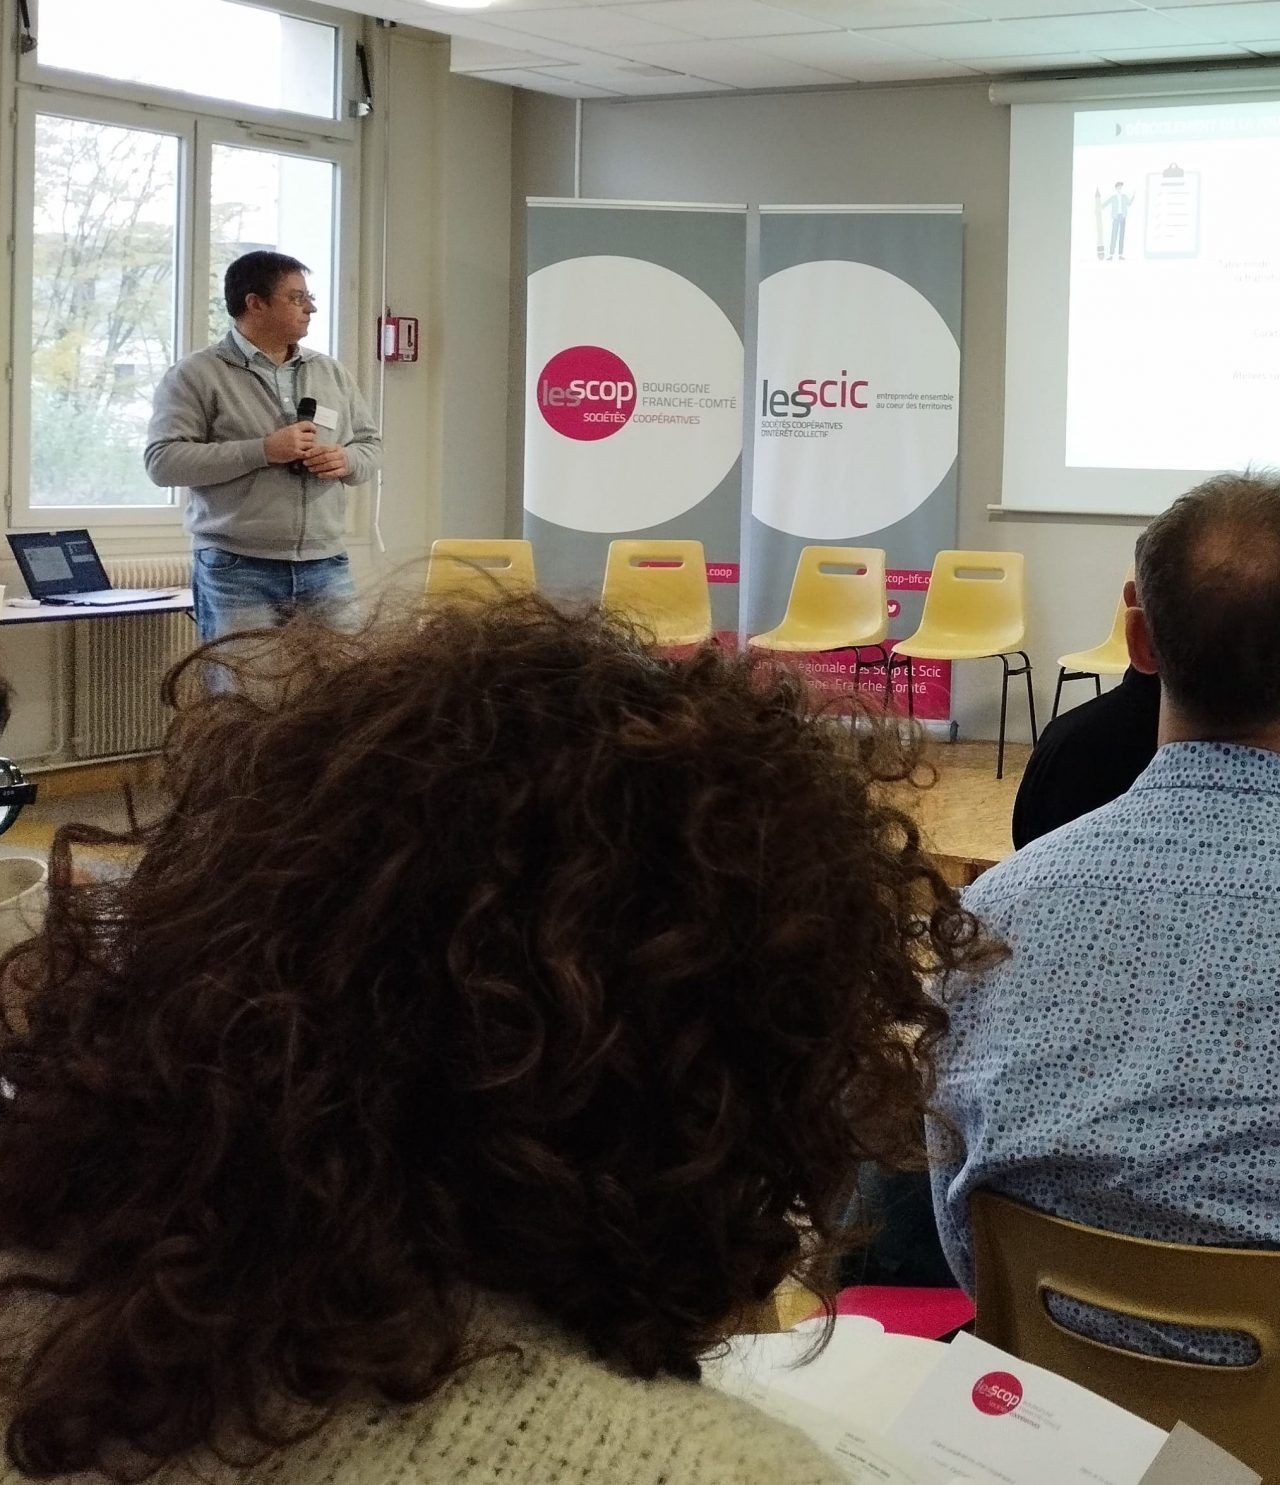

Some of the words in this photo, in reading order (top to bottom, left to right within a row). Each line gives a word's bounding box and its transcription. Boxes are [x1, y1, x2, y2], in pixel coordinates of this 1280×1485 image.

[642, 382, 711, 394] BOURGOGNE
[642, 396, 737, 409] FRANCHE-COMTÉ
[876, 392, 919, 402] entreprendre
[920, 393, 954, 402] ensemble
[918, 402, 953, 411] territoires
[583, 411, 626, 423] SOCIÉTÉS
[632, 413, 701, 425] COOPÉRATIVES
[792, 420, 843, 430] COOPÉRATIVES
[918, 665, 941, 678] Scic
